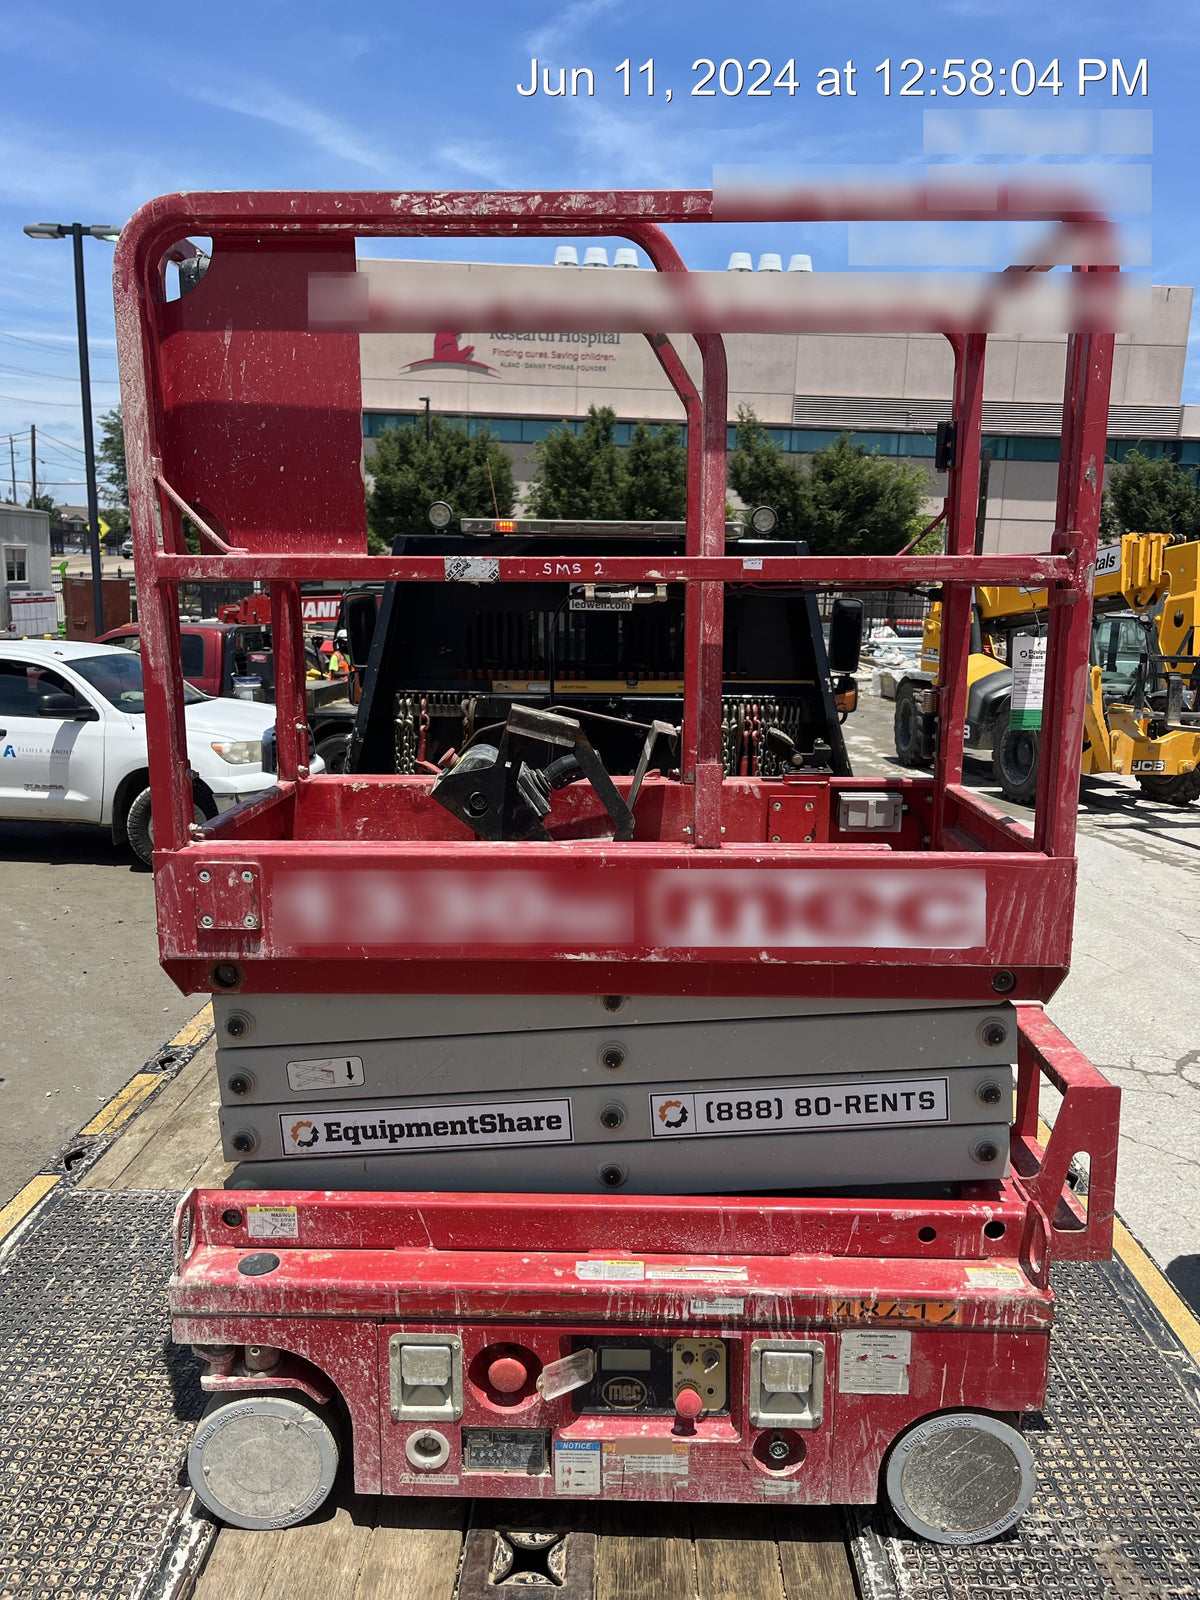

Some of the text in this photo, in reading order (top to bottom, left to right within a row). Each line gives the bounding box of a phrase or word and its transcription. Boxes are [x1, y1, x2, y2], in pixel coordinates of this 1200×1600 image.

[558, 332, 621, 347] Hospital
[492, 348, 617, 361] Finding cures. Saving children.
[542, 562, 604, 575] SMS 2
[301, 601, 341, 618] ANI
[1132, 761, 1164, 771] JCB
[706, 1090, 935, 1123] (888) 80-RENTS
[324, 1113, 563, 1146] EquipmentShare
[608, 1385, 641, 1401] mec
